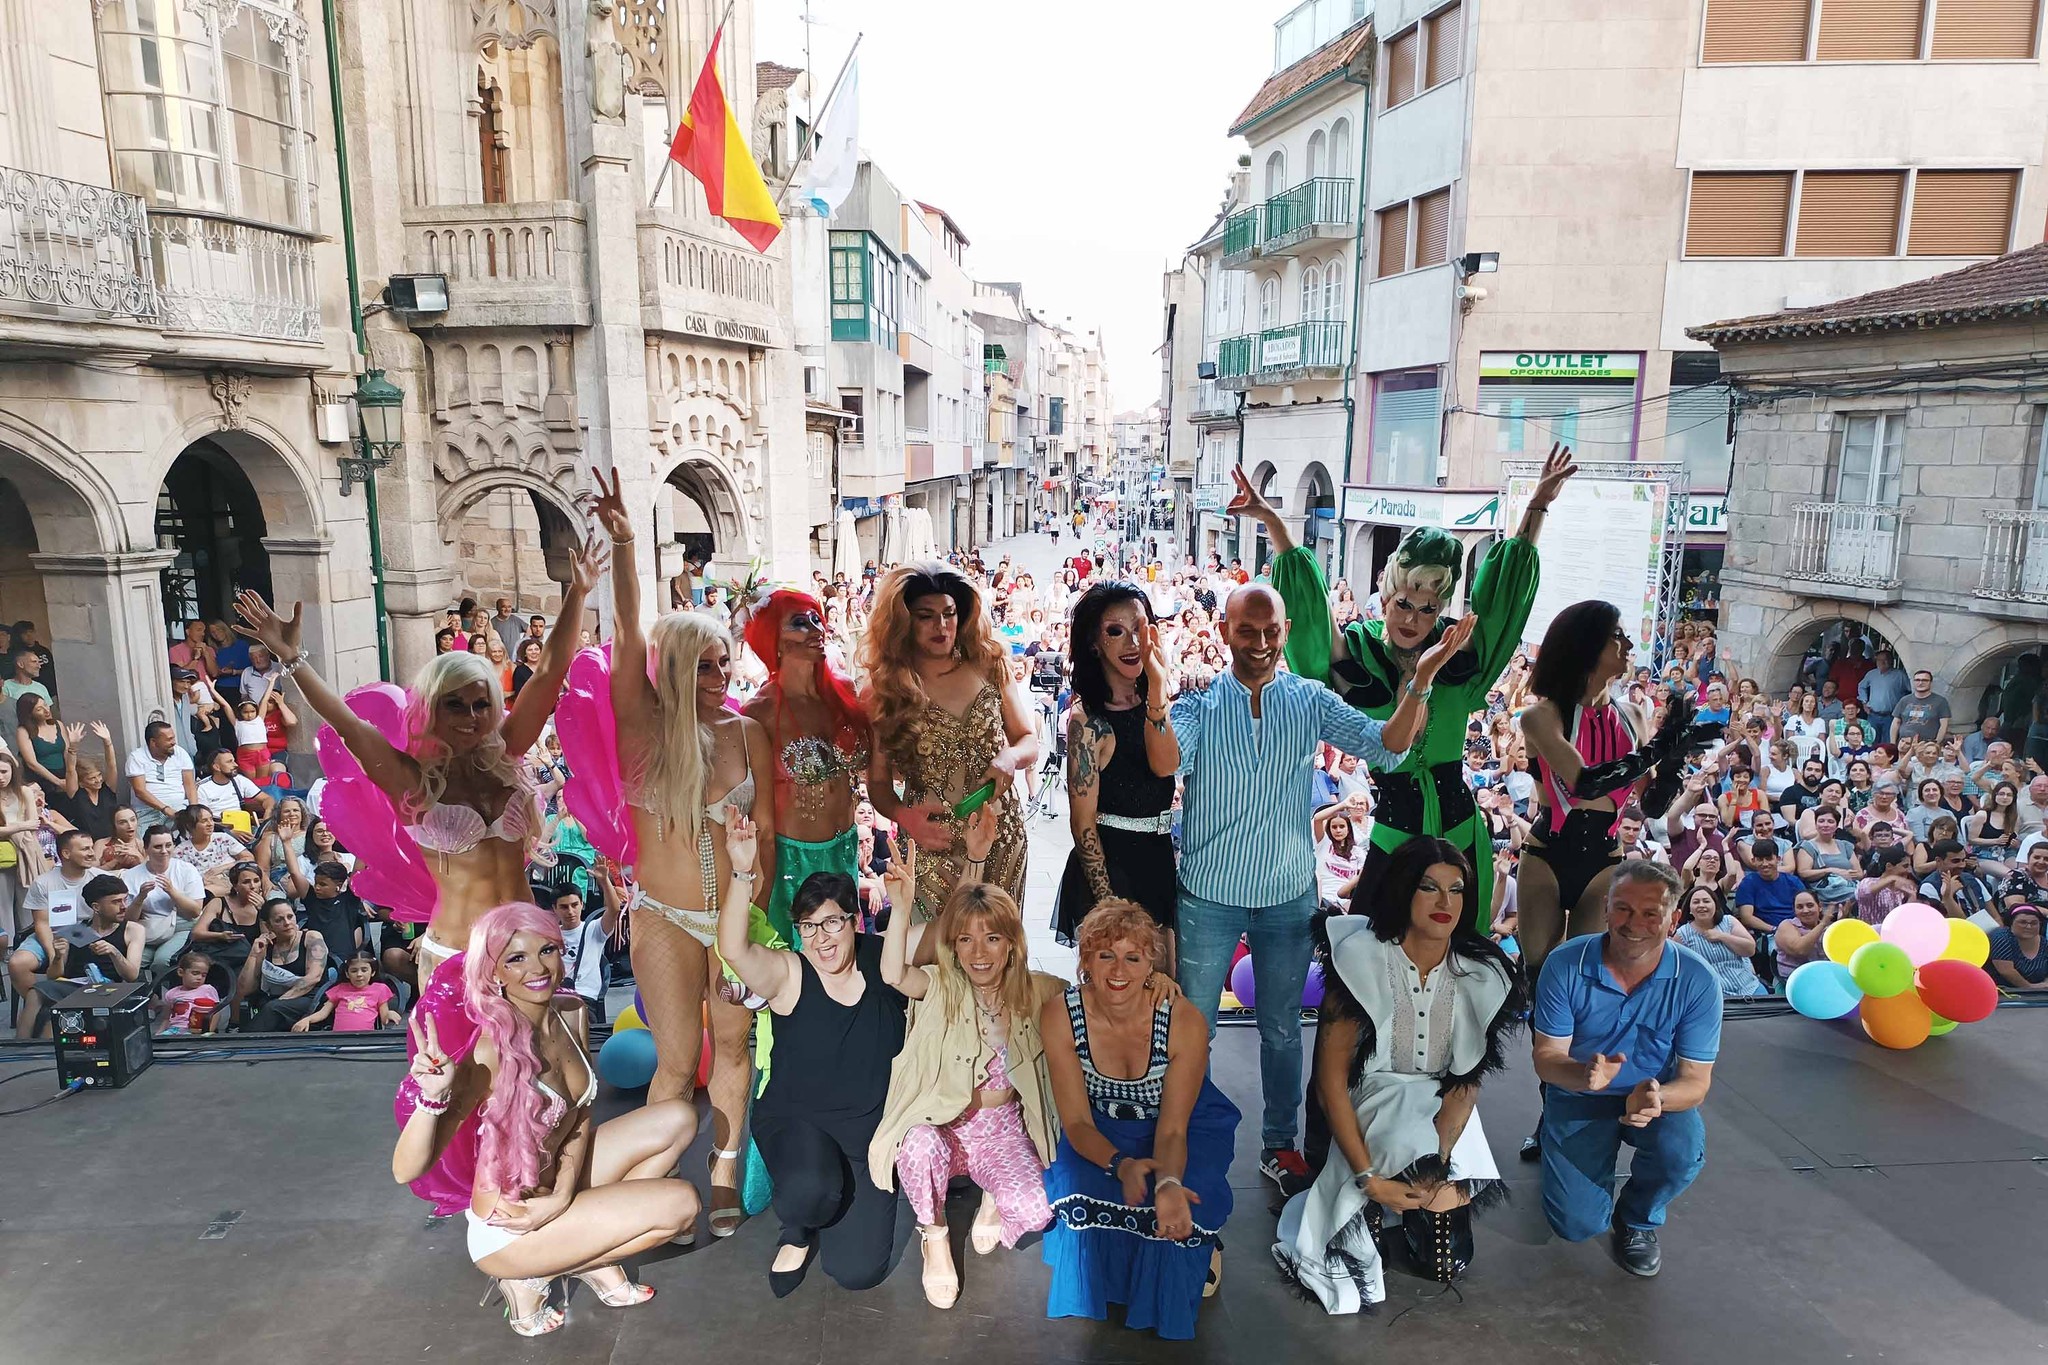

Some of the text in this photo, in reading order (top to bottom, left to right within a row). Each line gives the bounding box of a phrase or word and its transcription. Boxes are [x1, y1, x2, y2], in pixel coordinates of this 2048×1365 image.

[685, 315, 772, 344] CASA CONSISTORIAL
[1516, 353, 1608, 368] OUTLET
[1380, 498, 1416, 517] Parada
